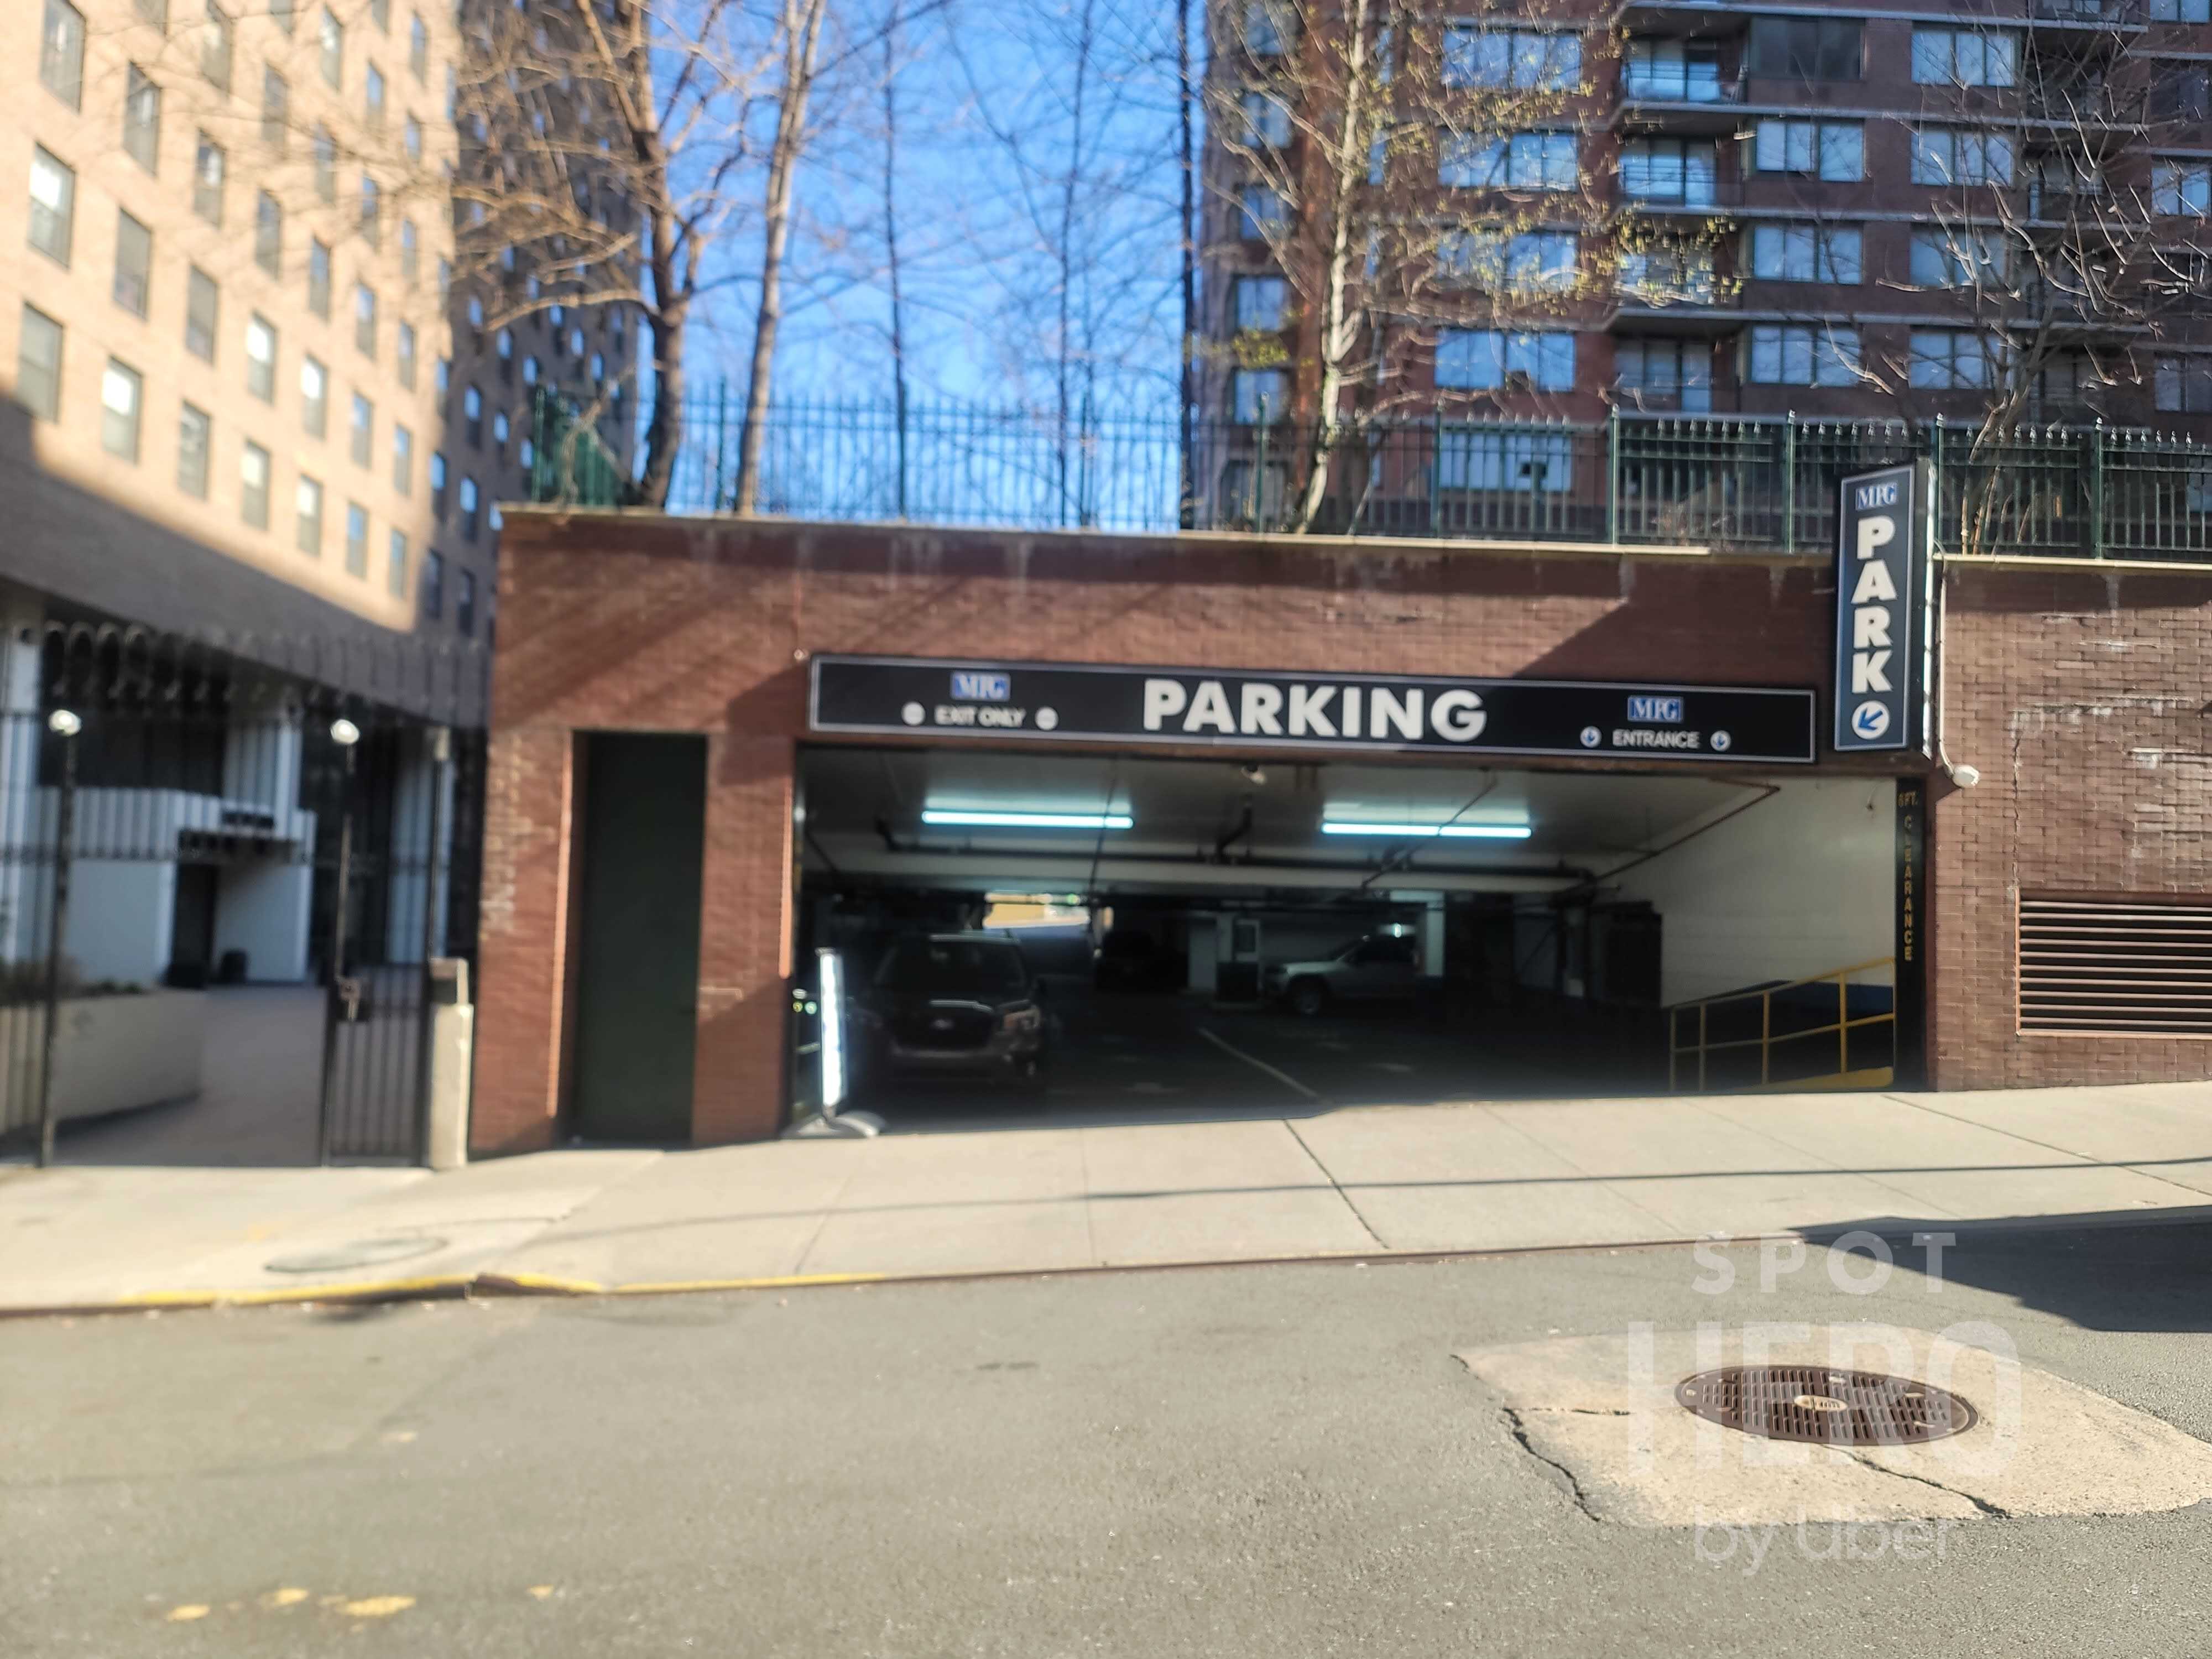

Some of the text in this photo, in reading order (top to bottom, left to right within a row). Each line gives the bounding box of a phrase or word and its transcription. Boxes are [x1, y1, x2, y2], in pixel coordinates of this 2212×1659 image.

[1851, 515, 1897, 693] PARK
[935, 705, 1026, 728] EXIT ONLY
[1144, 679, 1488, 742] PARKING
[1613, 728, 1702, 749] ENTRANCE
